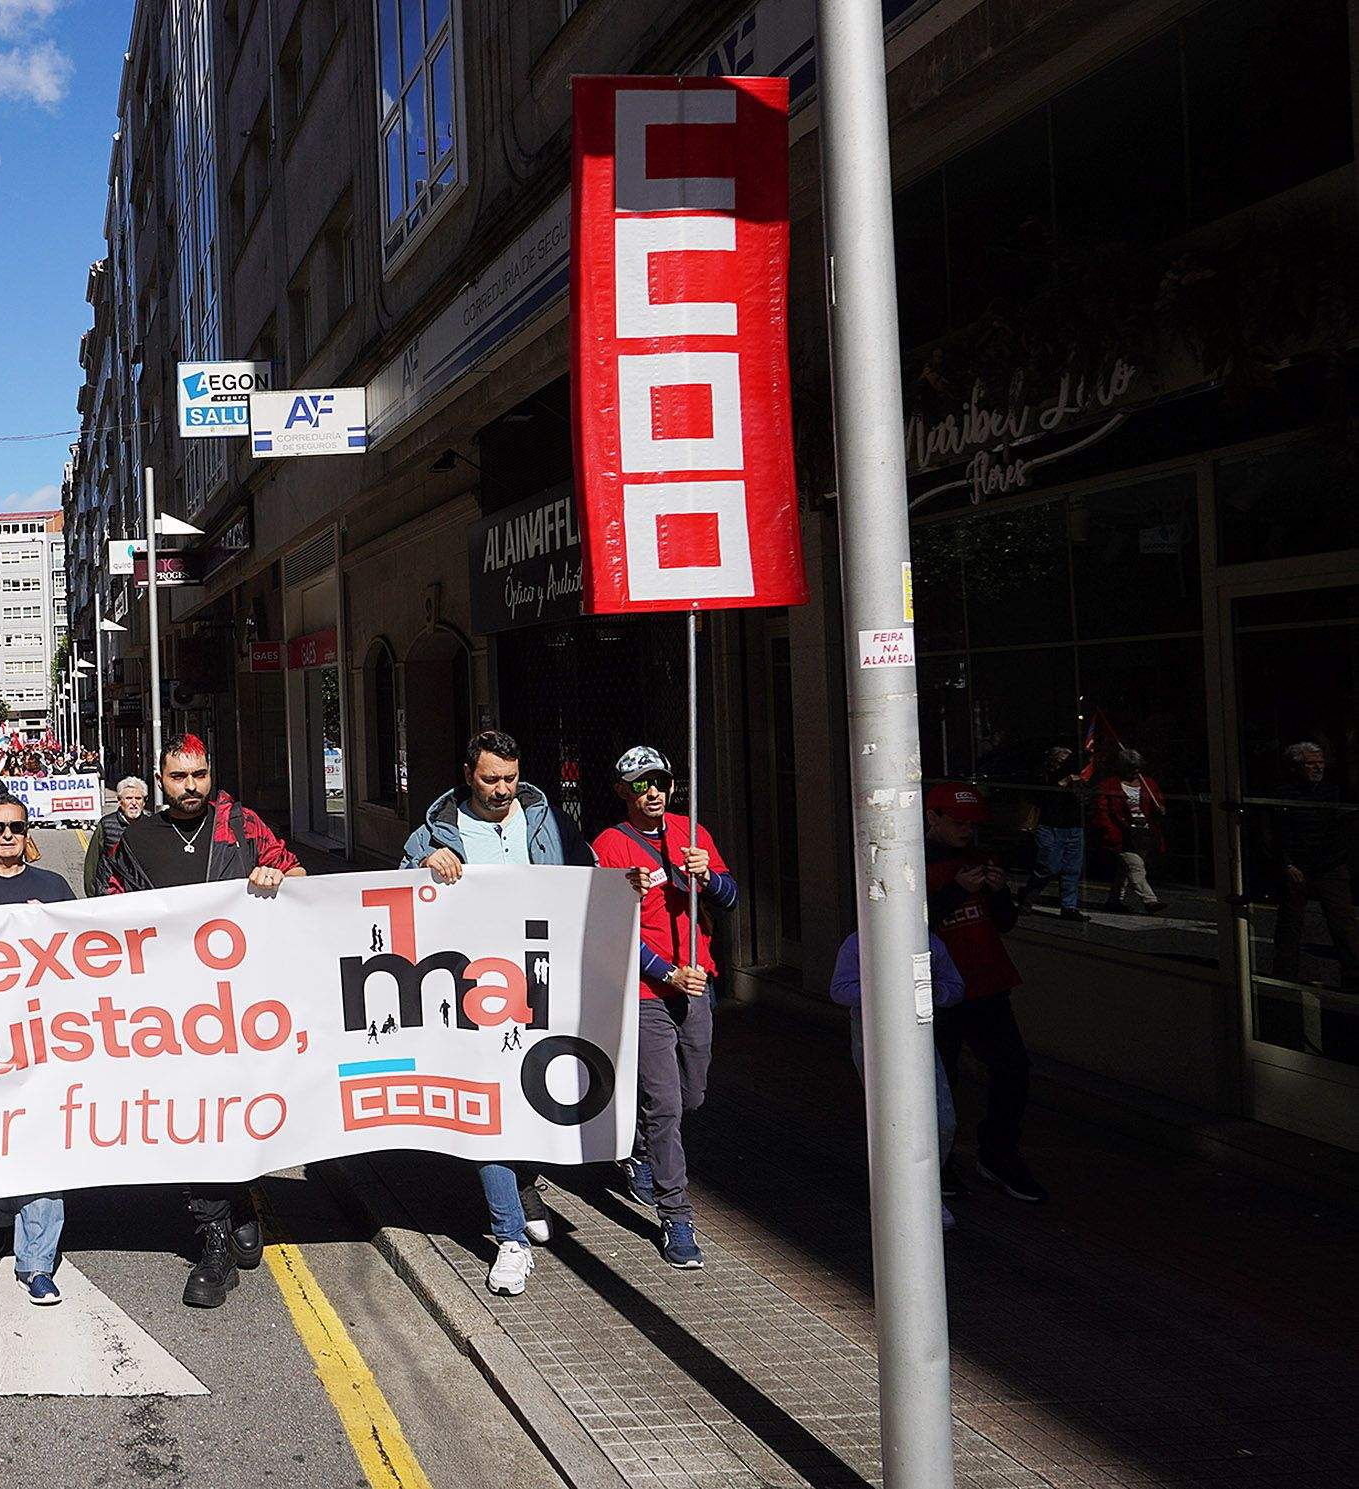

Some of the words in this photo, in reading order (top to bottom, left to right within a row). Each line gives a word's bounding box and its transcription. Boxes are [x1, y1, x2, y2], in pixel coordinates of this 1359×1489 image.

[614, 90, 755, 602] CCOO
[195, 373, 269, 391] AEGON
[872, 632, 904, 643] FEIRA
[882, 645, 900, 653] NA
[33, 778, 95, 792] LABORAL
[53, 799, 92, 811] CCOO
[193, 918, 248, 971] o
[351, 1085, 491, 1126] CCOO
[59, 1082, 288, 1150] futuro
